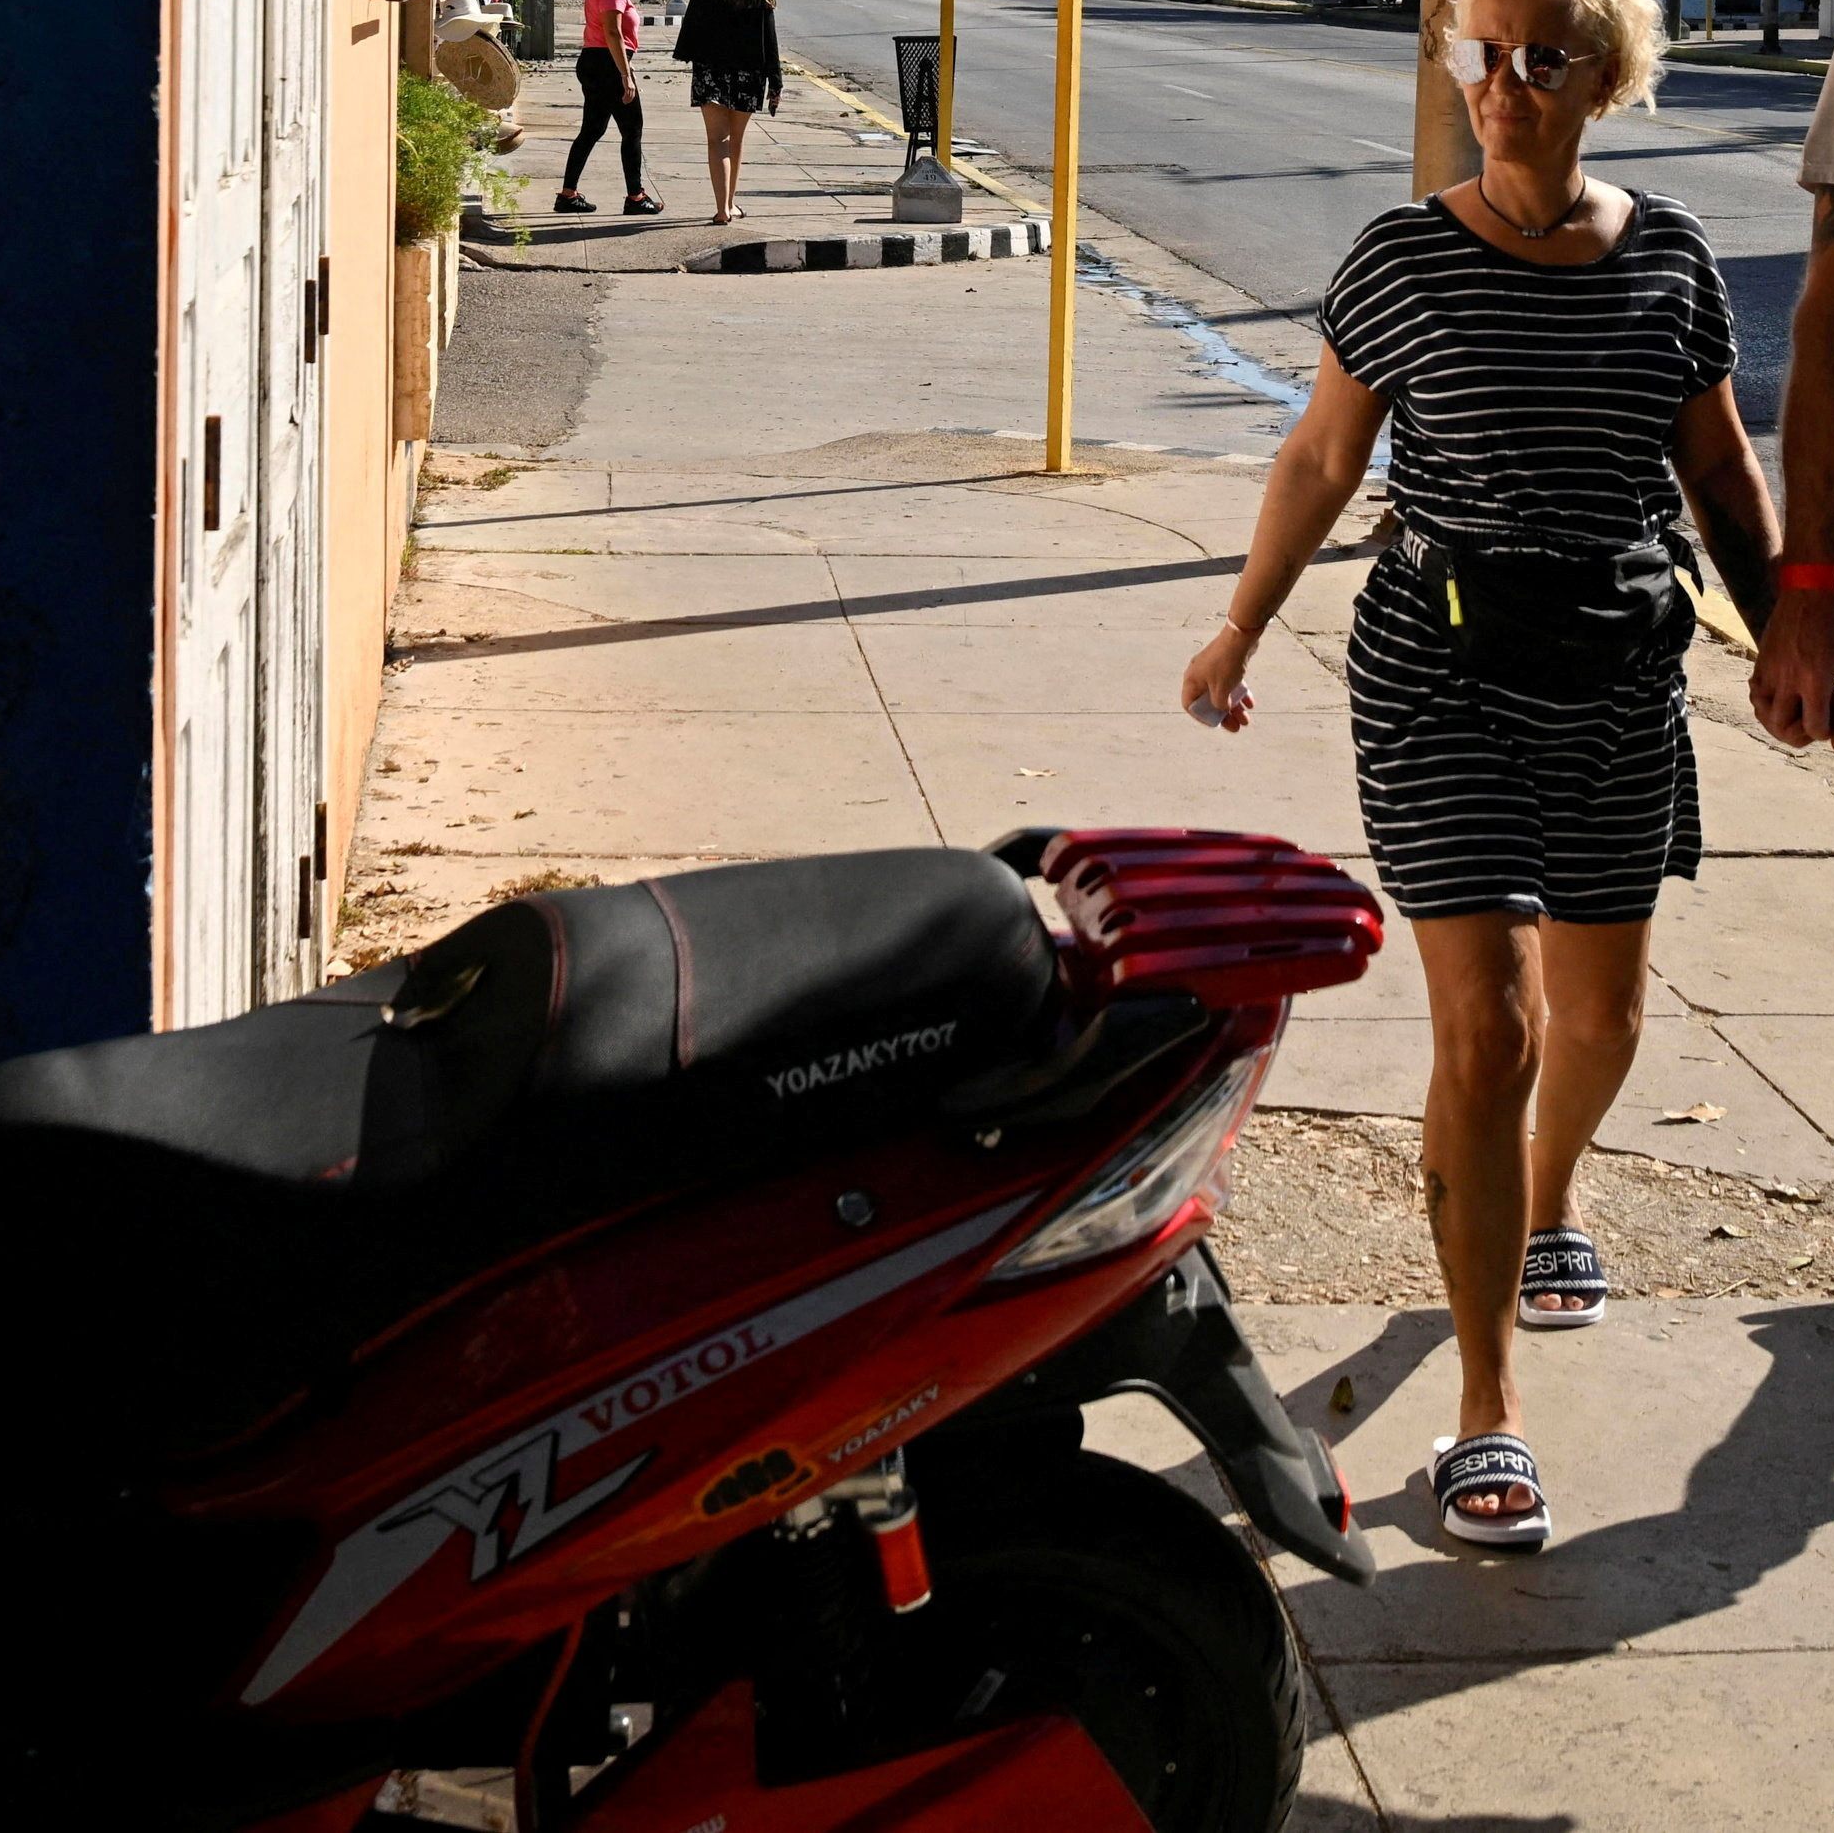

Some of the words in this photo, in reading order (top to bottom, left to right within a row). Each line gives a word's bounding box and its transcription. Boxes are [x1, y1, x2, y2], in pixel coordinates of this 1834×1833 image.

[766, 1020, 957, 1099] YOAZAKY707
[1525, 1250, 1594, 1277] ESPRIT
[578, 1323, 776, 1435] VOTOL
[826, 1382, 941, 1464] YOAZAKY
[1449, 1450, 1536, 1480] ESPRIT
[374, 1427, 661, 1584] YZ
